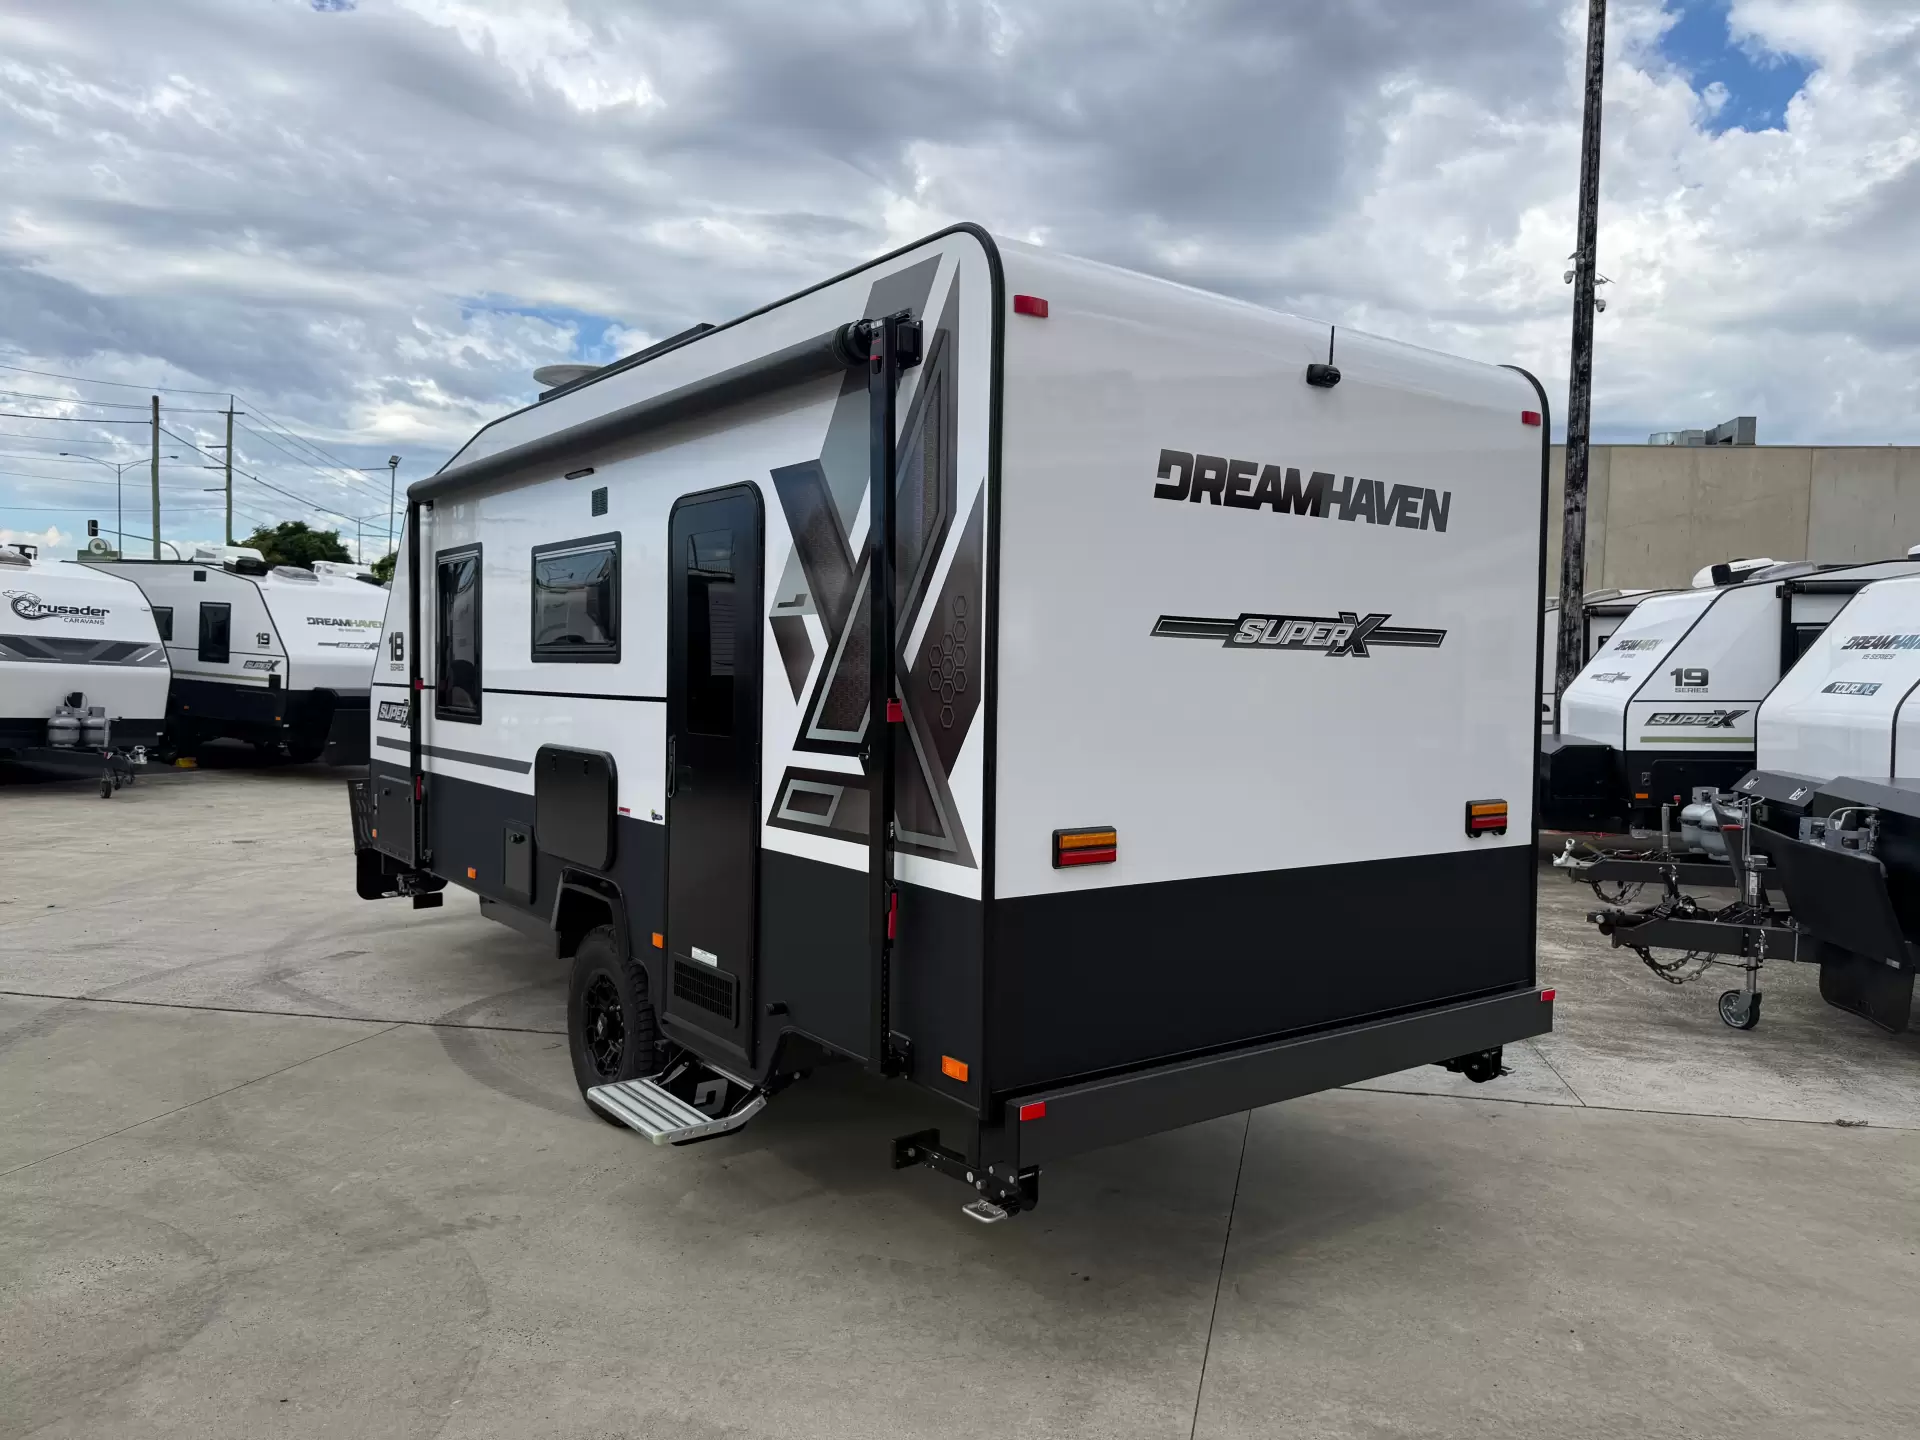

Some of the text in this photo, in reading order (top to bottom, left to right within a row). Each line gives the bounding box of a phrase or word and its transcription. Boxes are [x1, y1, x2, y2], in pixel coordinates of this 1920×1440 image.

[1154, 449, 1451, 533] DREAMHAVEN
[63, 617, 105, 625] CARAVANS
[256, 632, 270, 646] 19
[388, 632, 404, 661] 18
[1670, 668, 1709, 687] 19
[1831, 682, 1879, 695] TOURLINE
